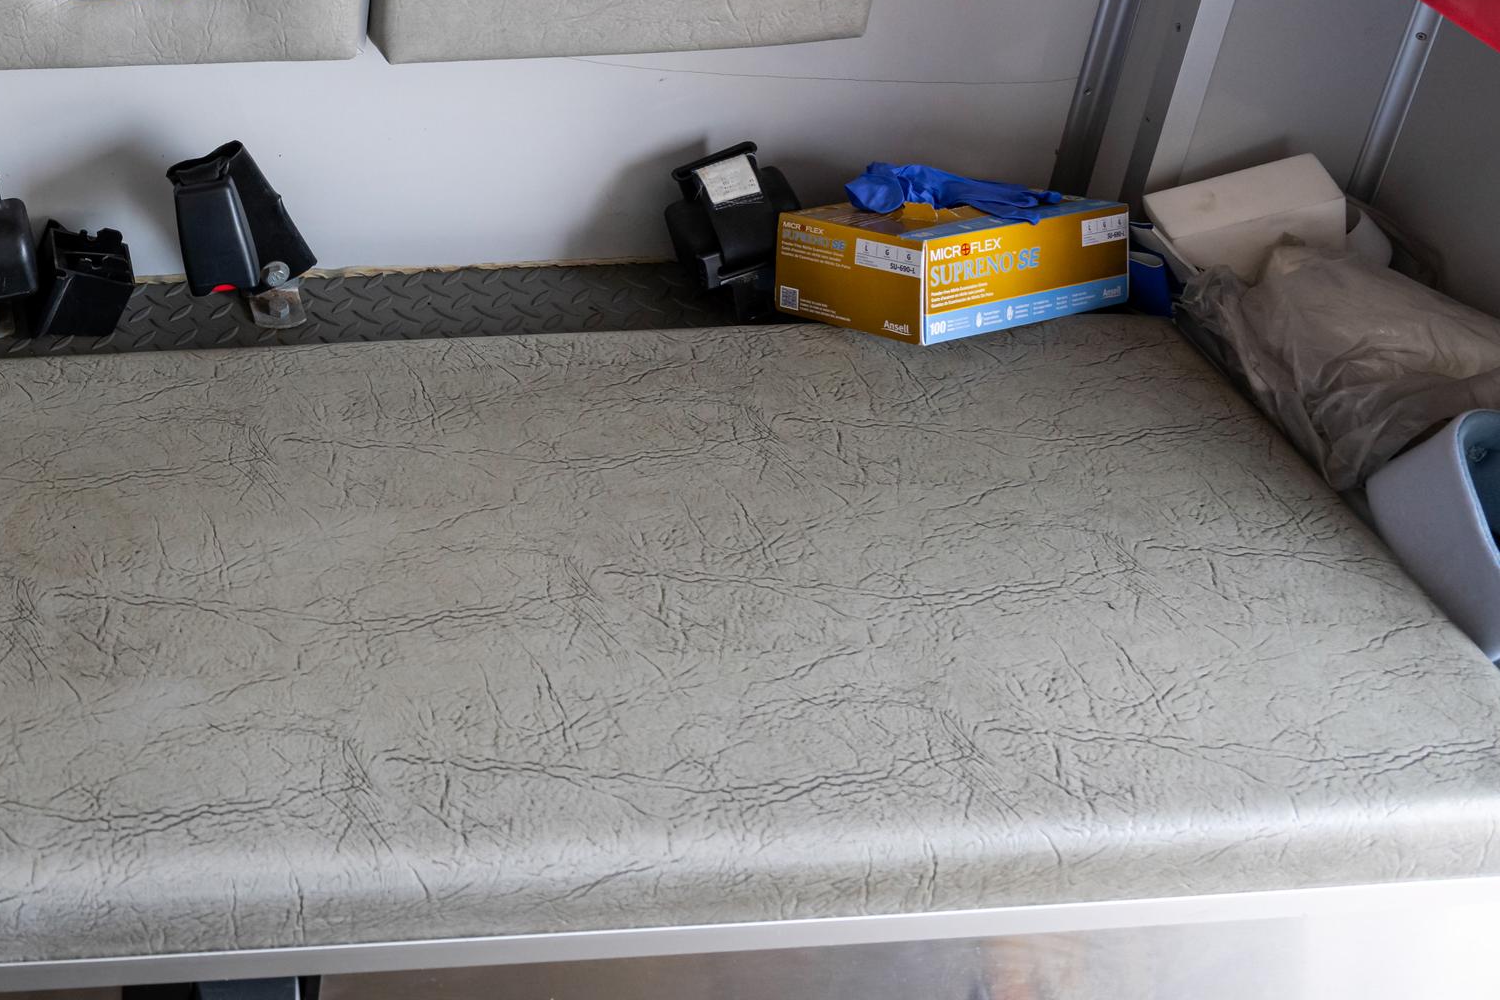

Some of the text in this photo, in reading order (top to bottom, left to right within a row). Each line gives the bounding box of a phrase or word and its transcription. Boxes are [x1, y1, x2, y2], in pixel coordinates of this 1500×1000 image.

[832, 240, 845, 250] SE
[890, 262, 916, 274] SU-690-L
[930, 247, 1041, 287] SUPRENO SE
[884, 320, 910, 334] Ansell
[930, 320, 946, 336] 100
